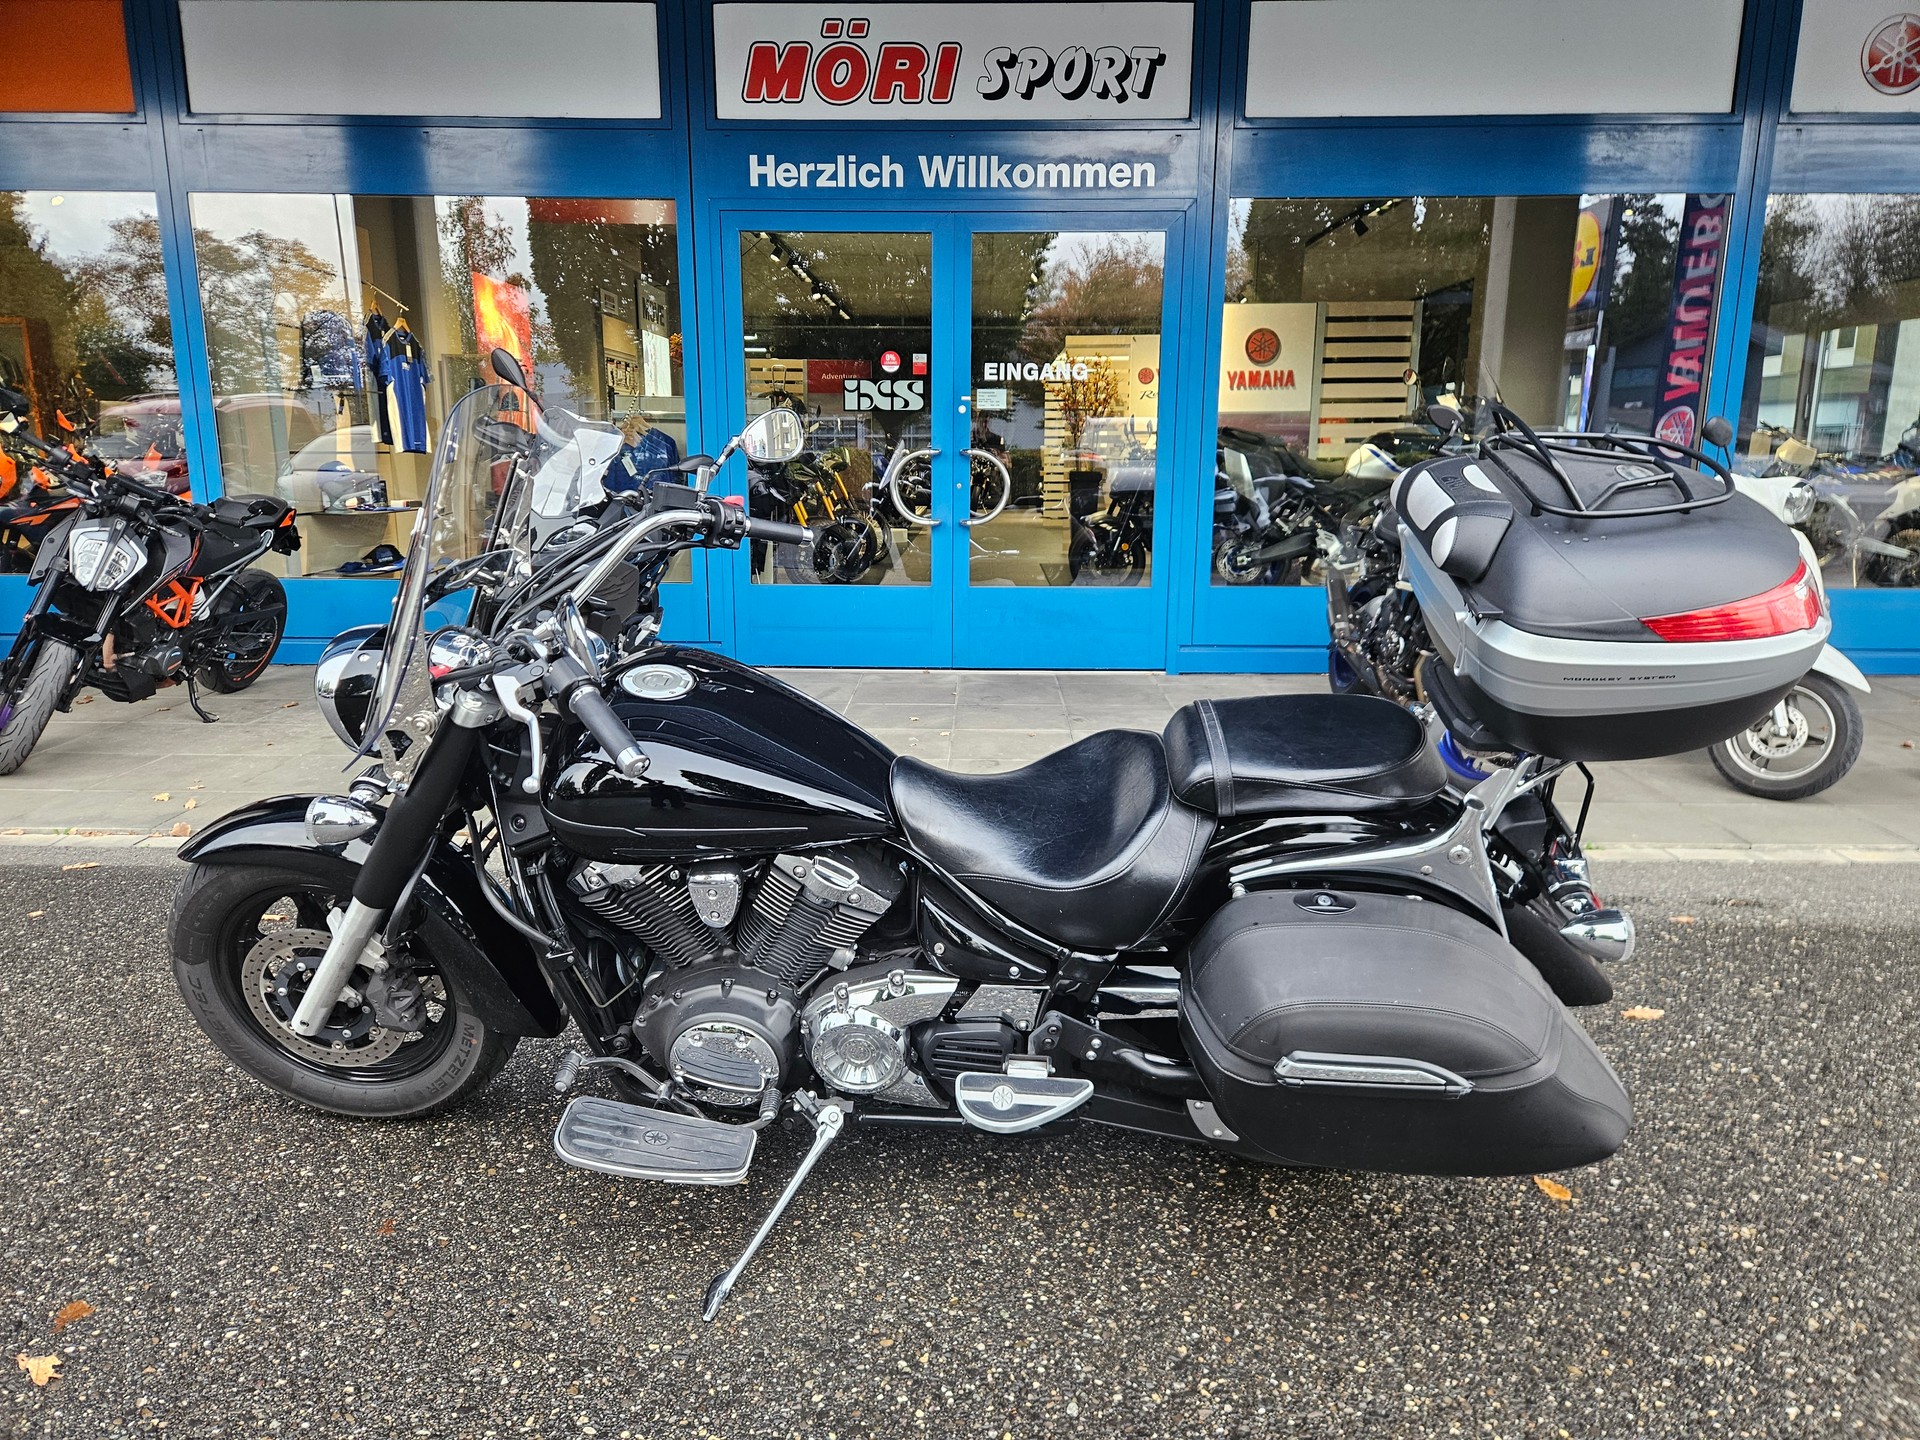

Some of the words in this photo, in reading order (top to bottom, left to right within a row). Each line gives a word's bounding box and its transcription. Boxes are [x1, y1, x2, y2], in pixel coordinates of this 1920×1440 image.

[741, 18, 963, 106] MÖRI
[977, 46, 1167, 102] SPORT
[749, 154, 903, 187] Herzlich
[918, 154, 1155, 187] Willkommen
[984, 362, 1088, 381] EINGANG
[1227, 370, 1295, 389] YAMAHA
[426, 1023, 475, 1094] METZELER
